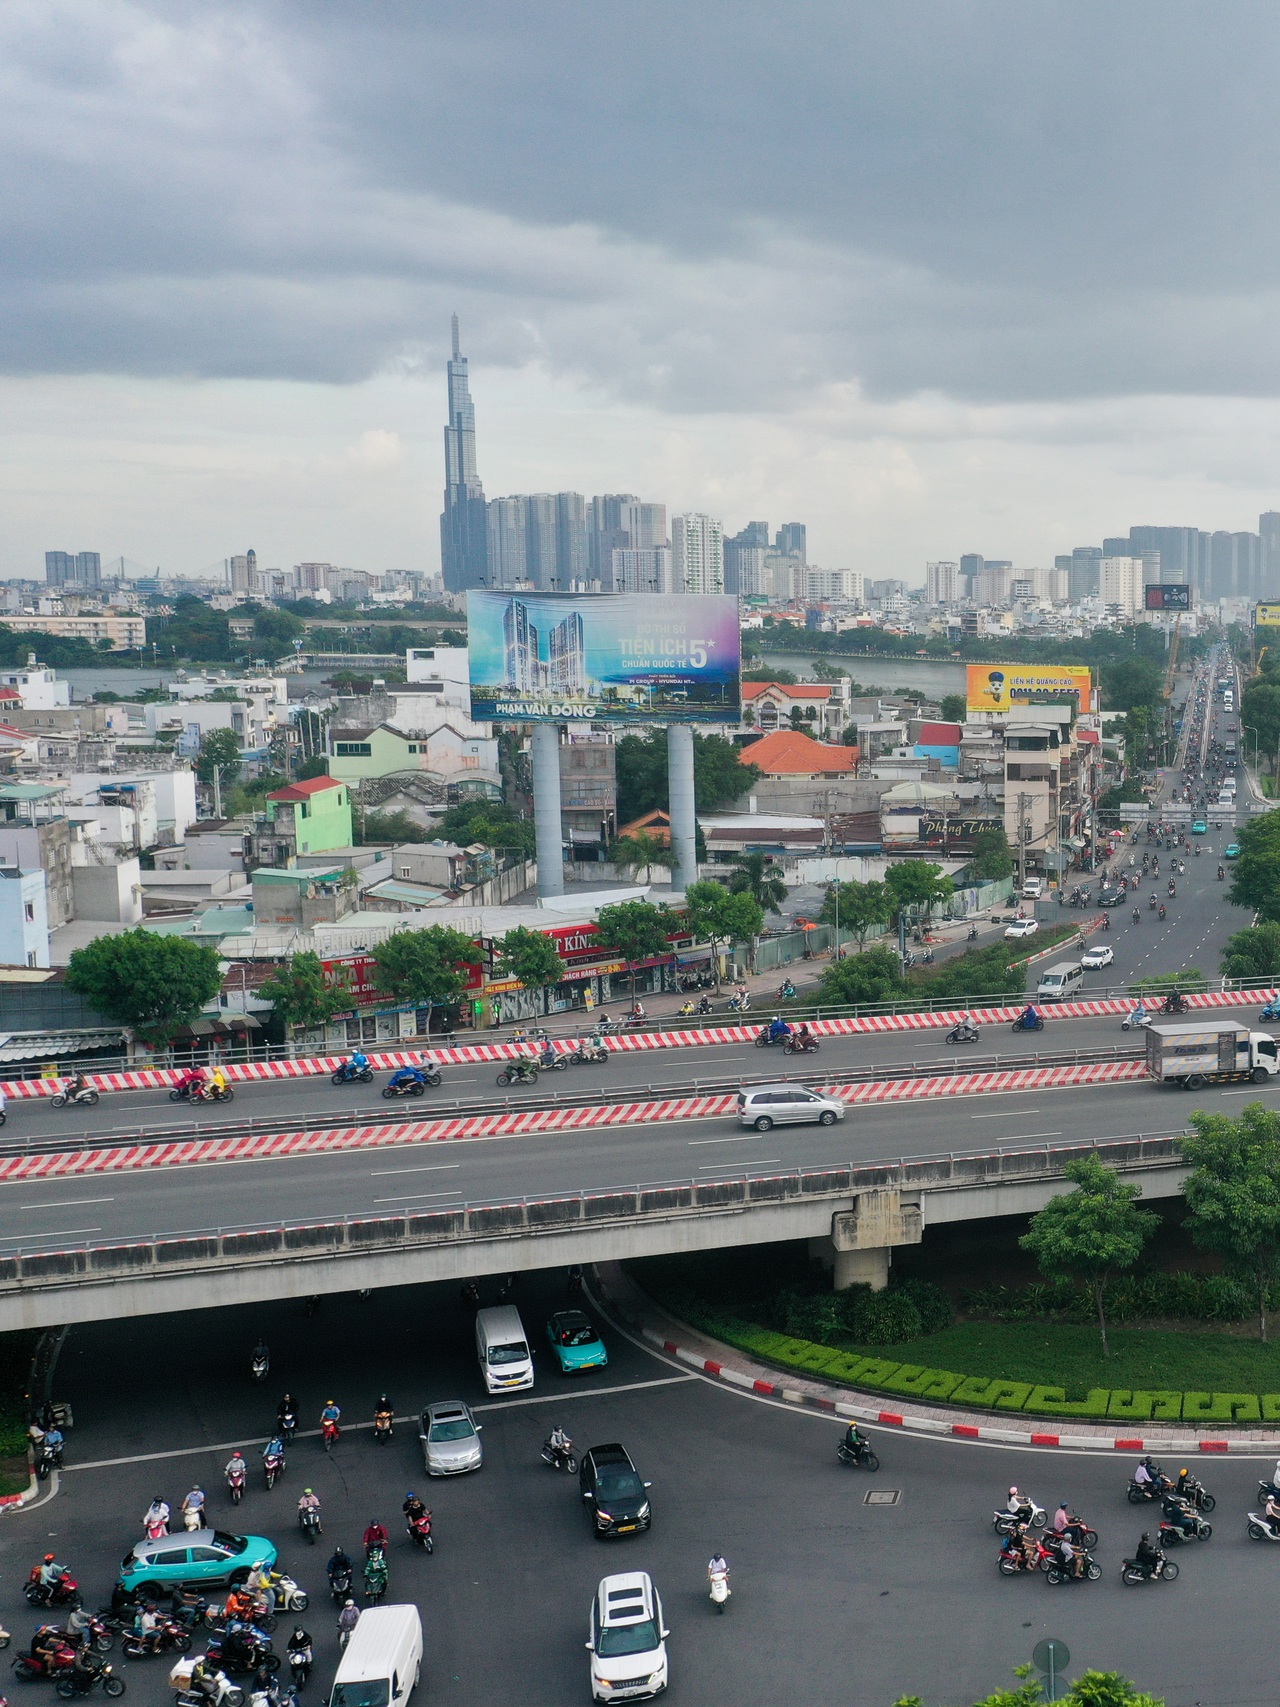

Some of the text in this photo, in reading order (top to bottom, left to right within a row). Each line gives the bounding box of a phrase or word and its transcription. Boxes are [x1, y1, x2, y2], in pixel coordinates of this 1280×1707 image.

[618, 635, 655, 656] TIỆN
[660, 635, 687, 655] ÍCH
[622, 655, 688, 668] CHUẨN QUỐC TẾ
[1010, 677, 1072, 686] LIÊN HỆ QUẢNG CÁO
[496, 703, 522, 716] PHẠM
[525, 701, 549, 715] VĂN
[923, 821, 962, 837] Phng
